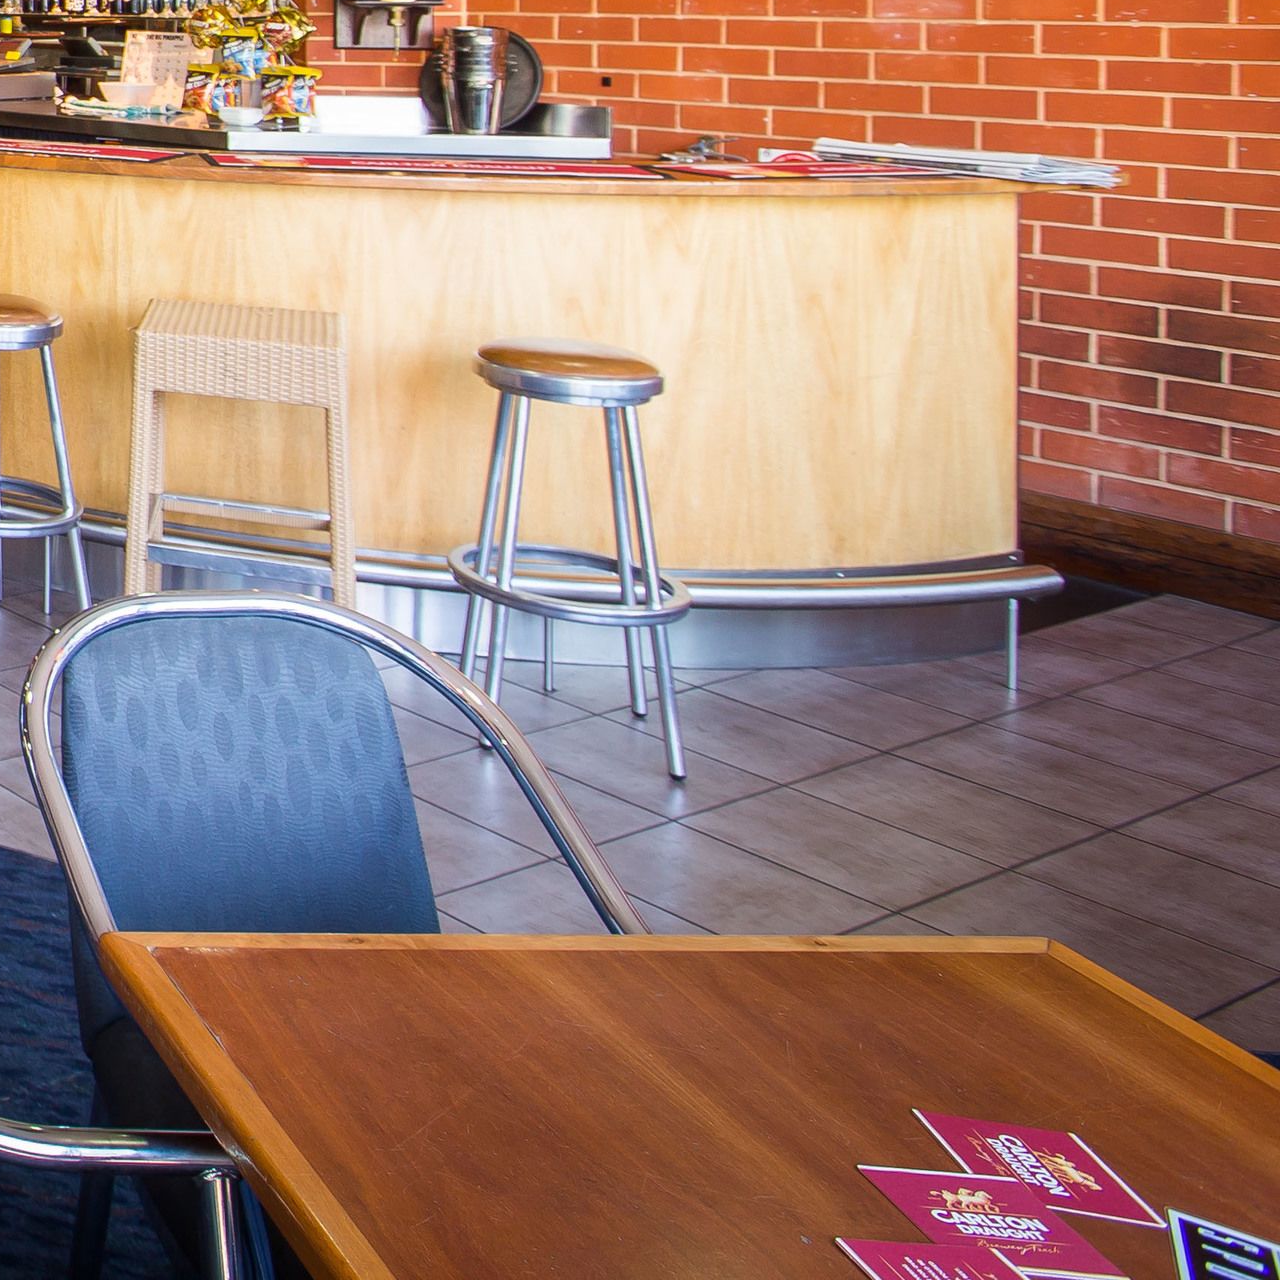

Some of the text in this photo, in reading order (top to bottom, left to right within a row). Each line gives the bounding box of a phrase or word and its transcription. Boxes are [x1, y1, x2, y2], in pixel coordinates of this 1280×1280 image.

[985, 1137, 1041, 1186] DRAUGHT
[998, 1134, 1071, 1197] CARLTON
[930, 1209, 1050, 1232] CARLTON
[956, 1224, 1046, 1241] DRAUGHT
